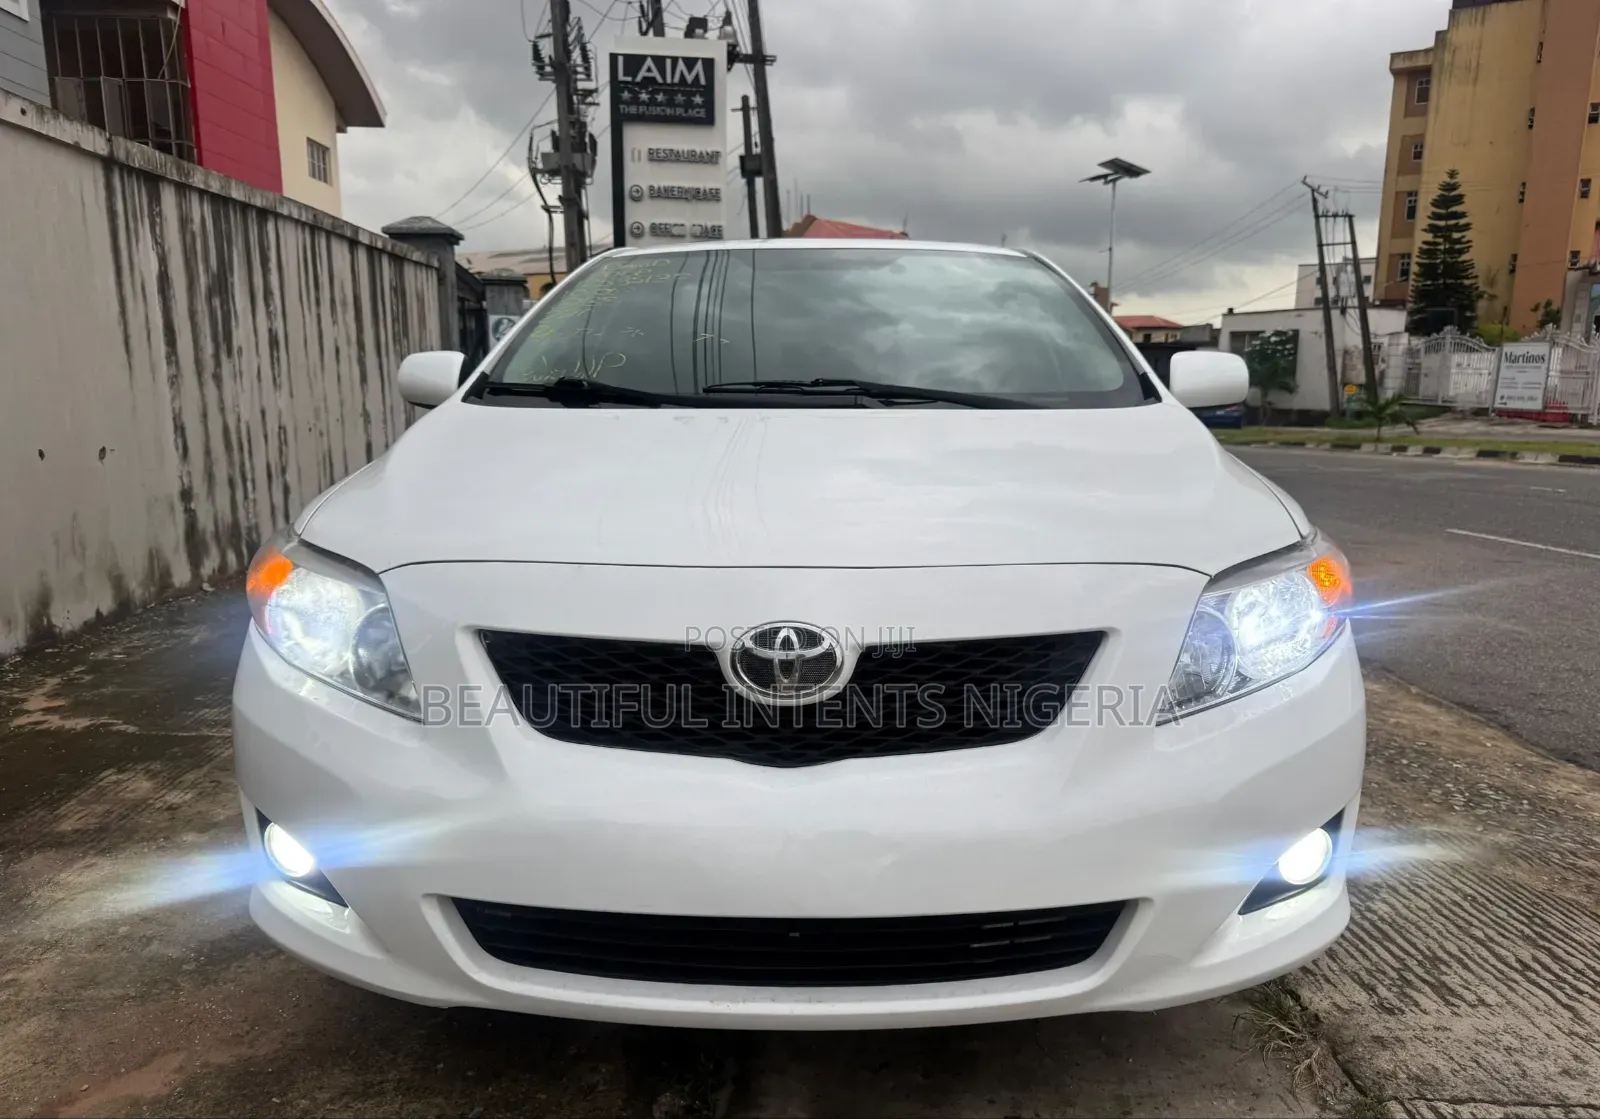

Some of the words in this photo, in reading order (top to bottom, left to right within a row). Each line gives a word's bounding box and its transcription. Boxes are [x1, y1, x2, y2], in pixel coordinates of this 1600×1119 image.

[617, 55, 706, 85] LAIM
[618, 104, 638, 115] THE
[675, 106, 707, 118] PLACE
[648, 148, 721, 164] RESTAURANT
[1504, 351, 1546, 364] Martinos
